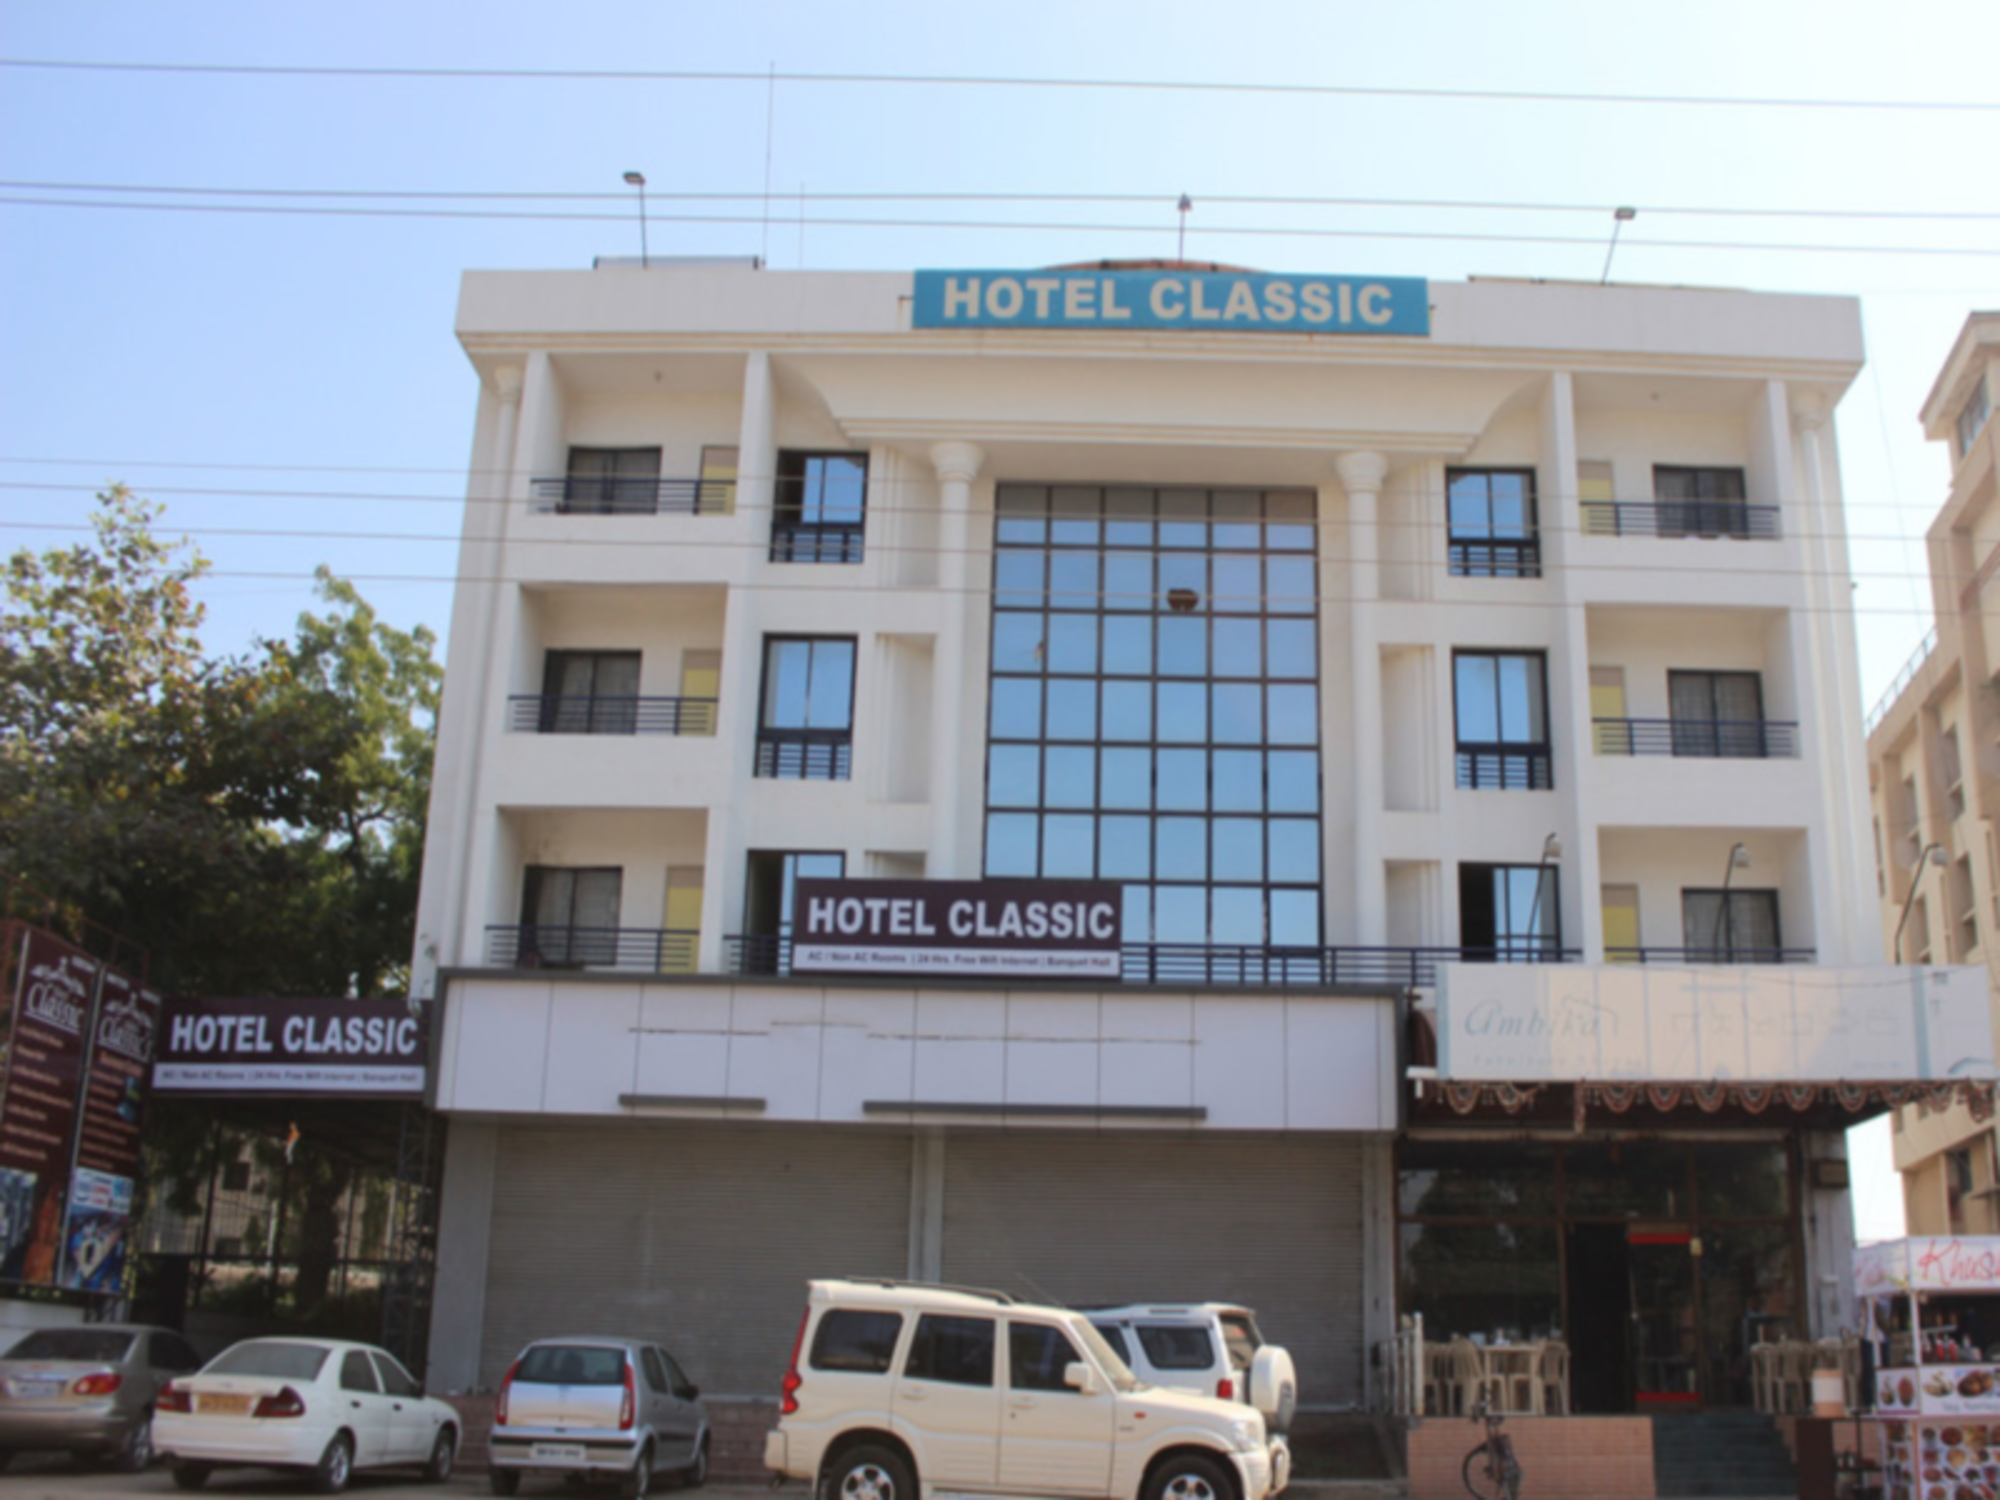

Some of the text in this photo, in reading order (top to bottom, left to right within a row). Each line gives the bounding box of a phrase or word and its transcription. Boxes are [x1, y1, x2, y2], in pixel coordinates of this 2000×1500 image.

[943, 277, 1394, 325] HOTEL CLASSIC
[807, 897, 1115, 939] HOTEL CLASSIC
[807, 951, 823, 962] AC
[170, 1015, 419, 1056] HOTEL CLASSIC
[1918, 1238, 2000, 1286] Khus
